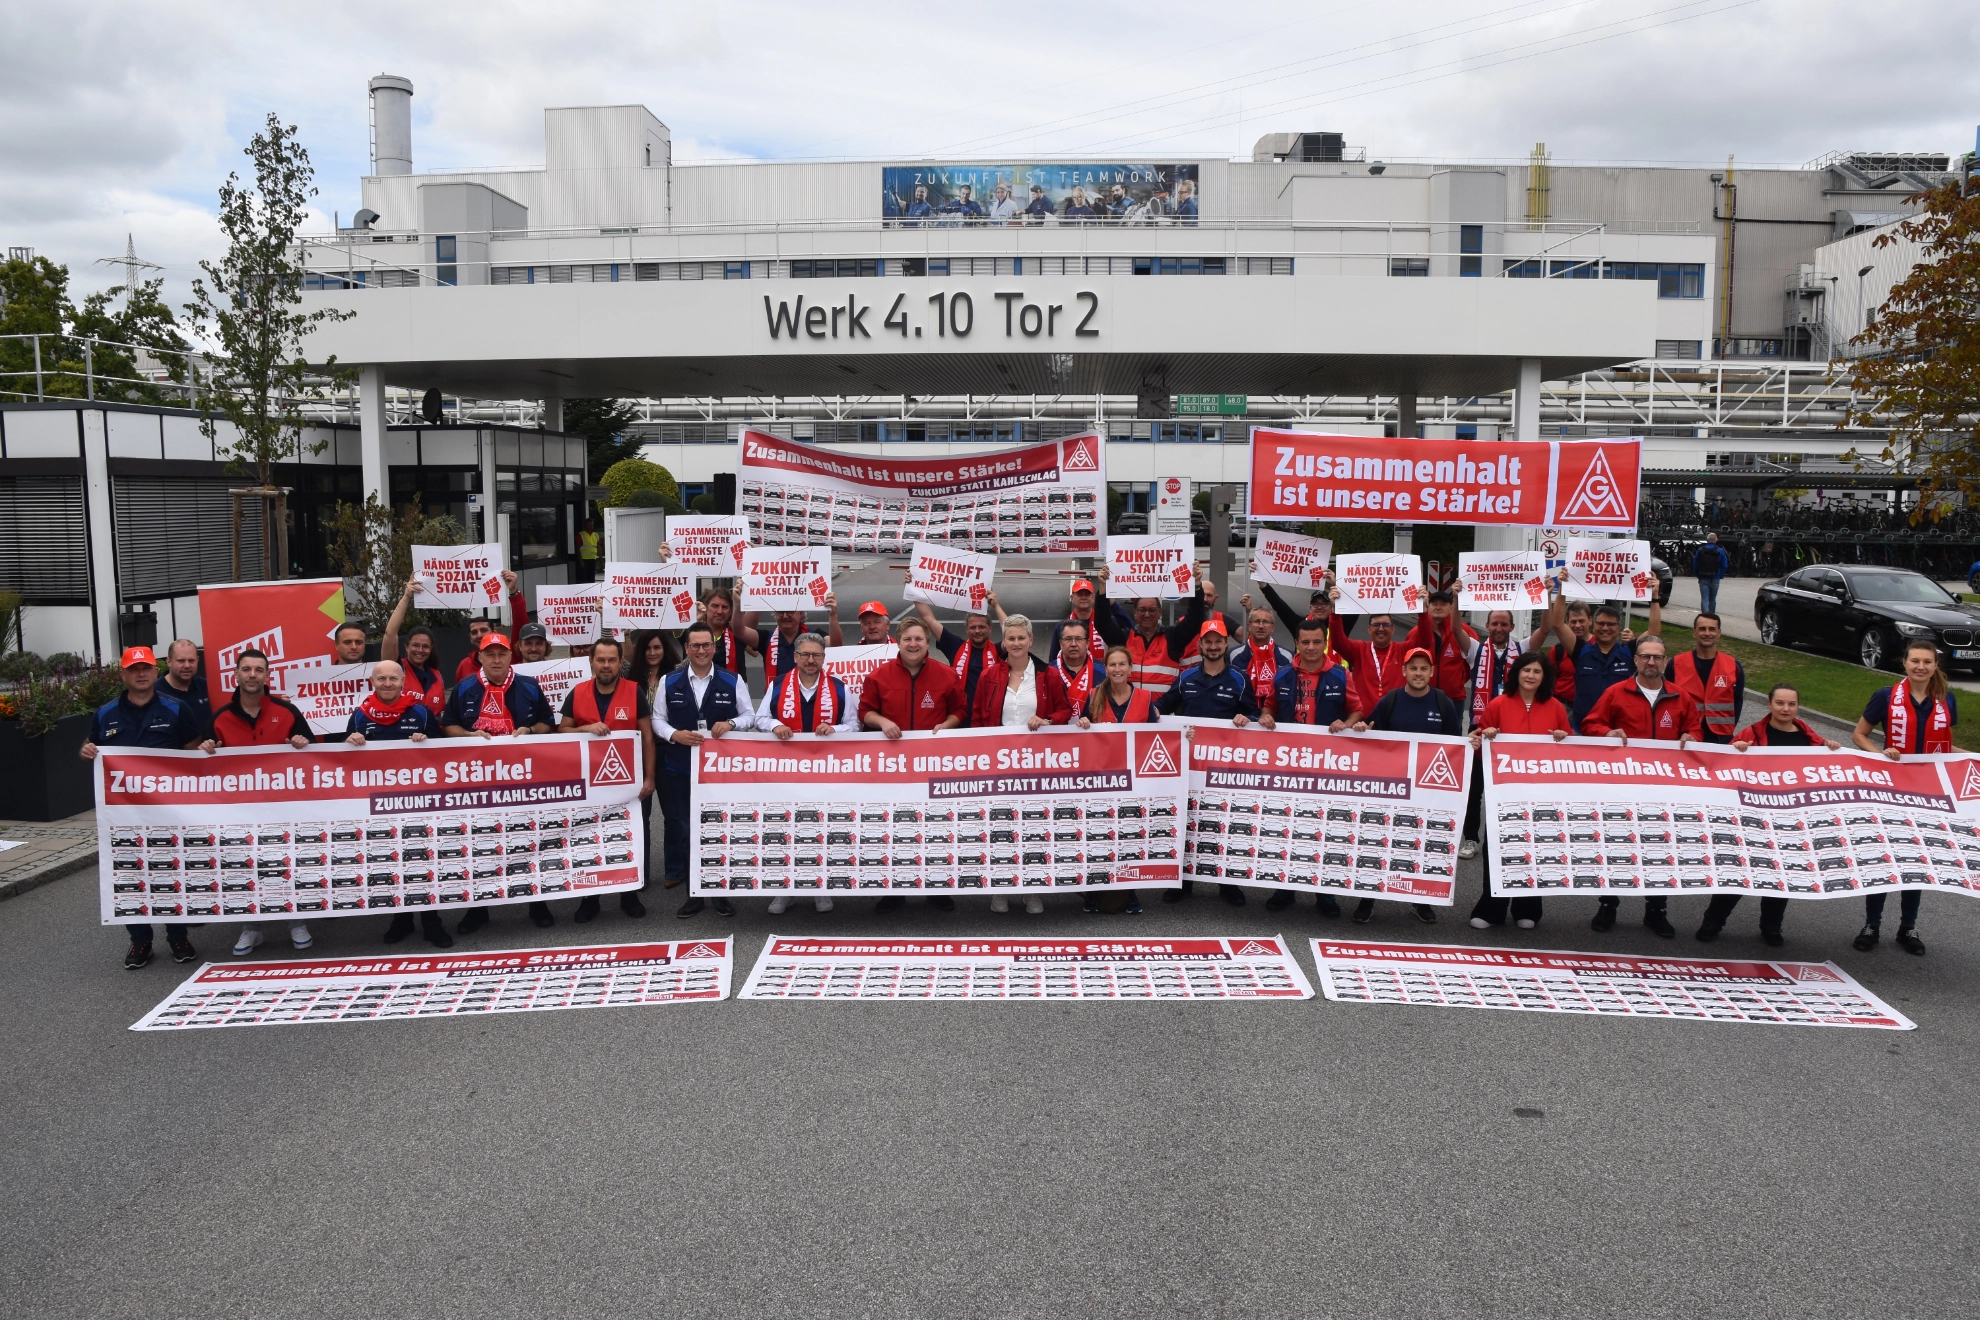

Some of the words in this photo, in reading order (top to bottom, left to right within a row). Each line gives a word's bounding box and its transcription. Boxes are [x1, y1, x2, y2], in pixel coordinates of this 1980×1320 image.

[914, 172, 1002, 185] ZUKUNFT
[1016, 171, 1046, 184] IST
[1060, 171, 1166, 184] TEAMWORK
[764, 294, 871, 338] Werk
[884, 292, 973, 337] 4.10
[994, 292, 1062, 337] Tor
[1075, 291, 1100, 336] 2
[1068, 442, 1094, 468] IGM
[747, 442, 864, 479] Zusammenhalt
[868, 466, 890, 481] ist
[894, 467, 954, 483] unsere
[959, 458, 1022, 480] Stärke!
[1274, 447, 1521, 485] Zusammenhalt
[911, 485, 958, 497] ZUKUNFT
[960, 480, 991, 492] STATT
[993, 470, 1057, 488] KAHLSCHLAG
[1567, 456, 1624, 517] IGM
[1274, 480, 1308, 505] ist
[1317, 487, 1410, 510] unsere
[1418, 488, 1521, 514] Stärke!
[674, 527, 743, 536] ZUSAMMENHALT
[675, 545, 723, 555] STÄRKSTE
[1116, 549, 1183, 562] ZUKUNFT
[1266, 541, 1296, 553] HÄNDE
[1299, 546, 1318, 557] WEG
[1575, 550, 1611, 561] HÄNDE
[1615, 553, 1638, 562] WEG
[424, 558, 460, 569] HÄNDE
[464, 558, 488, 569] WEG
[682, 558, 718, 566] MARKE.
[1275, 552, 1314, 566] SOZIAL-
[751, 561, 819, 575] ZUKUNFT
[919, 556, 983, 579] ZUKUNFT
[1130, 564, 1164, 574] STATT
[1272, 562, 1304, 574] STAAT
[1347, 565, 1383, 576] HÄNDE
[1386, 566, 1408, 575] WEG
[1466, 563, 1539, 572] ZUSAMMENHALT
[1587, 562, 1635, 574] SOZIAL-
[437, 570, 486, 581] SOZIAL-
[612, 576, 688, 585] ZUSAMMENHALT
[765, 576, 801, 586] STATT
[930, 573, 963, 587] STATT
[1360, 576, 1405, 587] SOZIAL-
[1586, 574, 1624, 584] STAAT
[436, 582, 476, 593] STAAT
[750, 588, 807, 596] KAHLSCHLAG!
[915, 580, 967, 597] KAHLSCHLAG!
[1358, 588, 1395, 599] STAAT
[1468, 582, 1516, 592] STÄRKSTE
[543, 596, 597, 606] ZUSAMMENH
[612, 595, 663, 606] STÄRKSTE
[1474, 593, 1512, 601] MARKE.
[568, 606, 597, 614] UNSER
[619, 608, 659, 618] MARKE.
[545, 615, 592, 626] STÄRKSTE
[553, 626, 589, 635] MARKE.
[826, 658, 896, 675] ZUKUN
[842, 675, 866, 684] STA
[315, 695, 355, 708] STATT
[1891, 705, 1907, 748] JETZT!
[704, 752, 872, 774] Zusammenhalt
[878, 753, 906, 773] ist
[913, 754, 990, 772] unsere
[997, 747, 1080, 769] Stärke!
[1142, 737, 1175, 772] IGM
[1193, 744, 1270, 764] unsere
[1275, 746, 1360, 771] Stärke!
[597, 746, 629, 781] IGM
[1423, 750, 1455, 786] IGM
[1497, 753, 1675, 778] Zusammenhalt
[1677, 762, 1712, 781] ist
[1714, 768, 1798, 786] unsere
[1803, 765, 1894, 787] Stärke!
[110, 766, 305, 793] Zusammenhalt
[312, 765, 345, 788] ist
[353, 767, 437, 787] unsere
[444, 758, 532, 784] Stärke!
[933, 780, 994, 795] ZUKUNFT
[998, 778, 1037, 791] STATT
[1042, 775, 1127, 790] KAHLSCHLAG
[1210, 772, 1270, 787] ZUKUNFT
[1273, 776, 1313, 790] STATT
[1317, 778, 1406, 795] KAHLSCHLAG
[375, 794, 441, 811] ZUKUNFT
[445, 791, 487, 806] STATT
[492, 784, 581, 803] KAHLSCHLAG
[1742, 791, 1806, 807] ZUKUNFT
[1811, 789, 1855, 803] STATT
[1860, 789, 1950, 810] KAHLSCHLAG
[778, 944, 954, 953] Zusammenhalt
[960, 944, 991, 953] ist
[998, 945, 1082, 953] unsere
[1086, 944, 1173, 953] Stärke!
[204, 962, 392, 980] Zusammenhalt
[397, 961, 431, 971] ist
[436, 958, 521, 970] unsere
[528, 952, 618, 964] Stärke!
[452, 967, 518, 977] ZUKUNFT
[519, 964, 568, 973] STATT
[571, 958, 666, 970] KAHLSCHLAG
[1325, 946, 1505, 963] Zusammenhalt
[1510, 955, 1544, 965] ist
[1549, 957, 1626, 968] unsere
[1637, 961, 1728, 975] Stärke!
[1578, 970, 1645, 978] ZUKUNFT
[1693, 974, 1791, 984] KAHLSCHLAG
